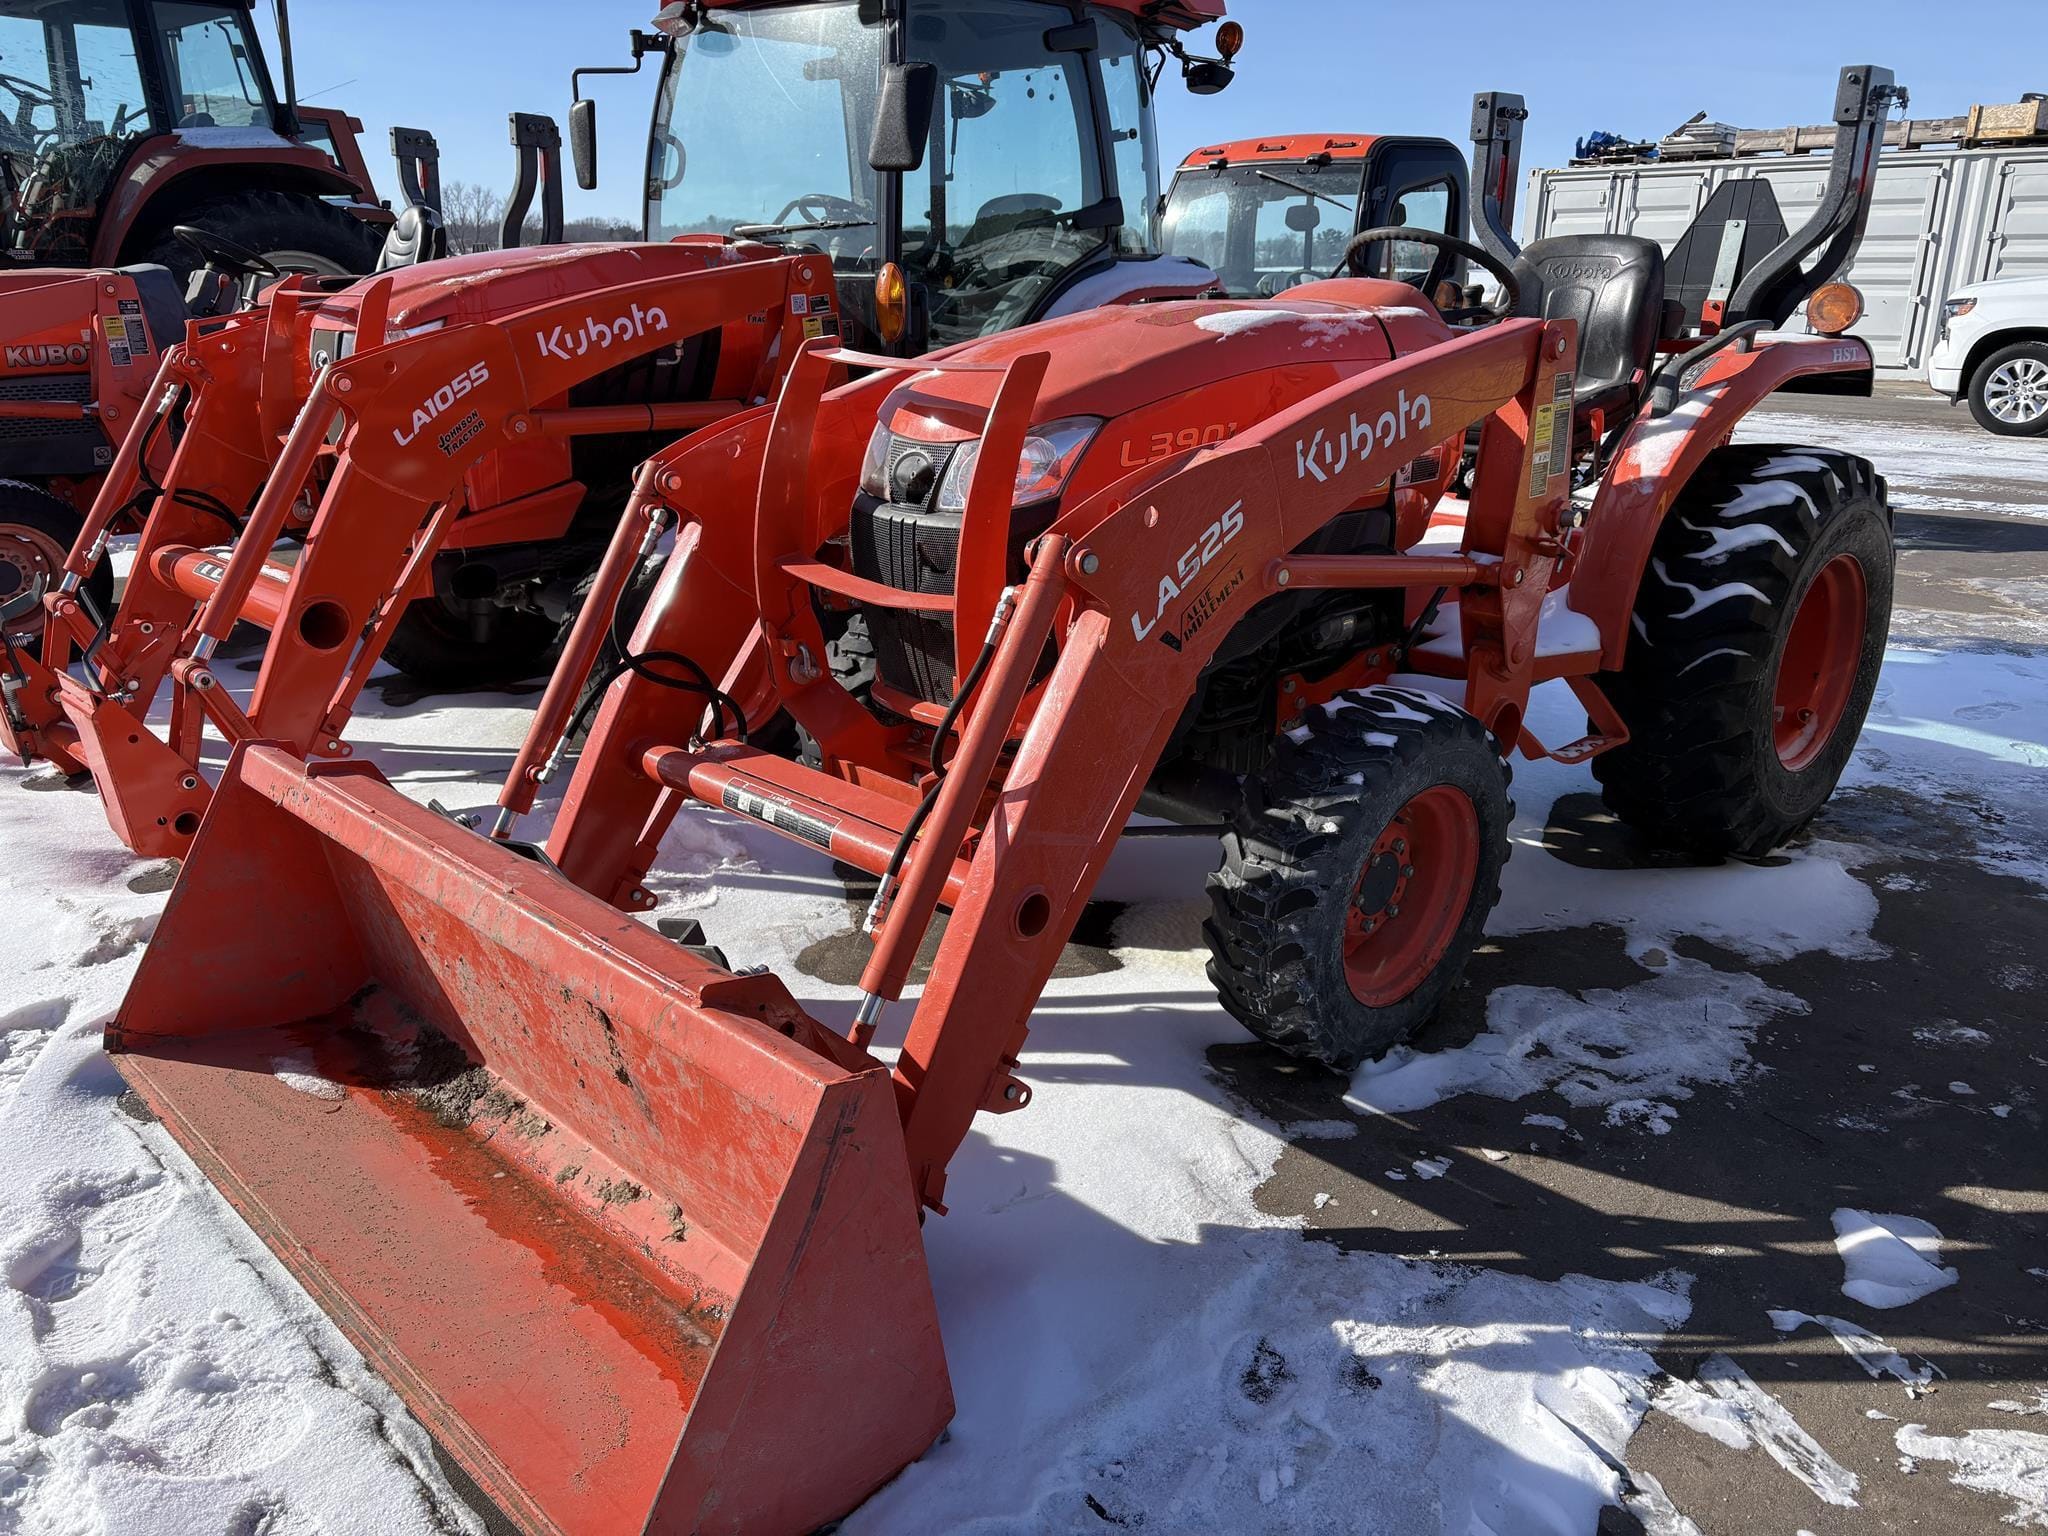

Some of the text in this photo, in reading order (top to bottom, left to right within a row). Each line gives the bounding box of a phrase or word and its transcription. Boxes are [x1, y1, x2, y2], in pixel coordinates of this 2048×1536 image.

[1545, 263, 1611, 279] Kubota
[536, 303, 669, 360] Kubota
[5, 343, 91, 368] KUBO
[1832, 347, 1858, 363] HST
[392, 360, 489, 446] LA1055
[438, 410, 479, 449] JOHNSON
[442, 419, 486, 458] TRACTOR
[1295, 389, 1431, 482] Kubota
[1130, 499, 1244, 642] LA525
